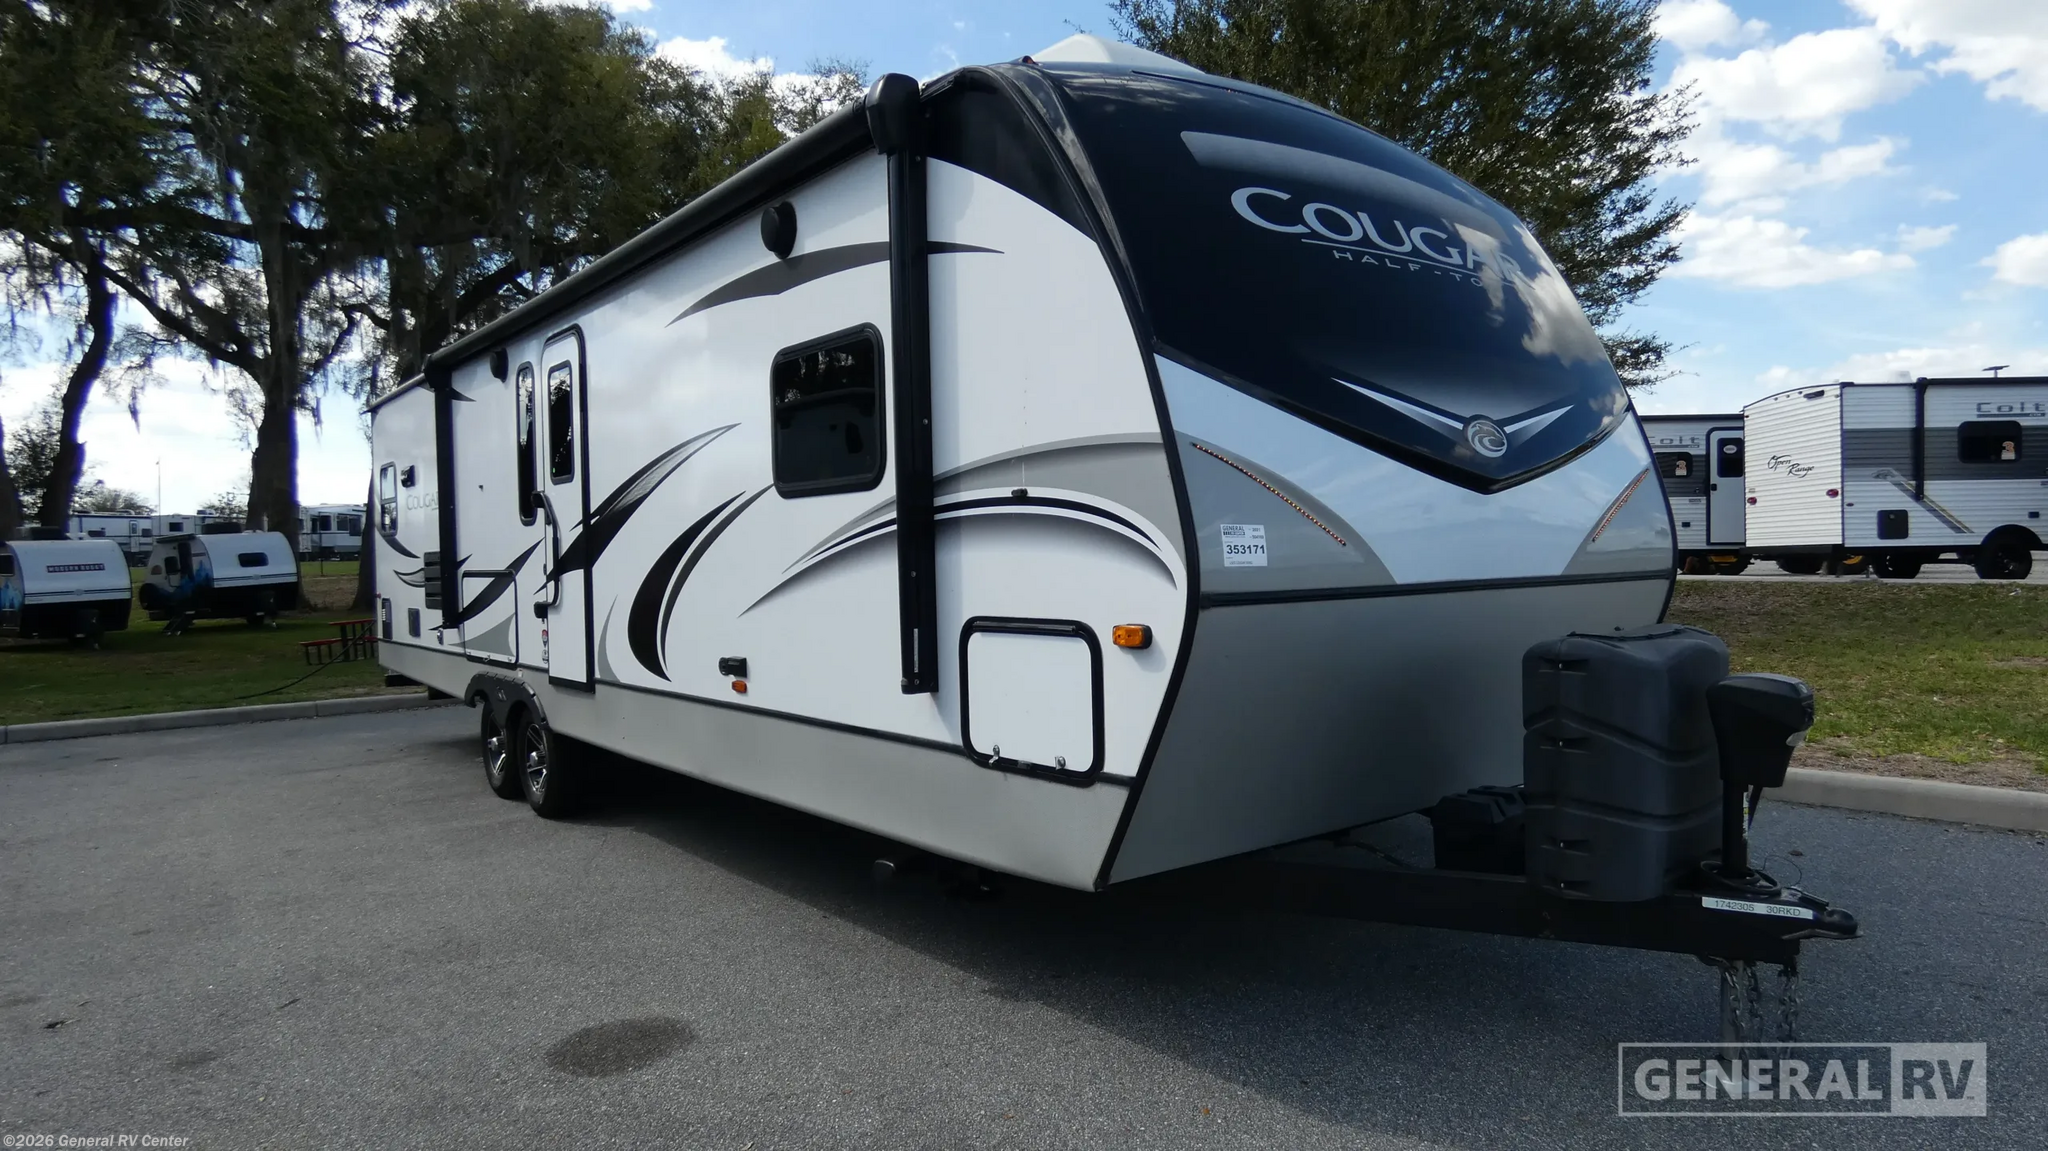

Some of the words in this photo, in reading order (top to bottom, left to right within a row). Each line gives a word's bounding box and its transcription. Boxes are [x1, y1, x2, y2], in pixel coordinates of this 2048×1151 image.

[1231, 187, 1536, 291] COUGAR
[1332, 250, 1485, 288] HALF-TO
[1976, 402, 2046, 412] Colt
[1767, 454, 1791, 471] Open
[1787, 463, 1815, 478] Range
[406, 491, 438, 511] COUGA
[1226, 544, 1265, 555] 353171
[1714, 900, 1755, 912] 1742305
[1766, 905, 1801, 917] 30RKD
